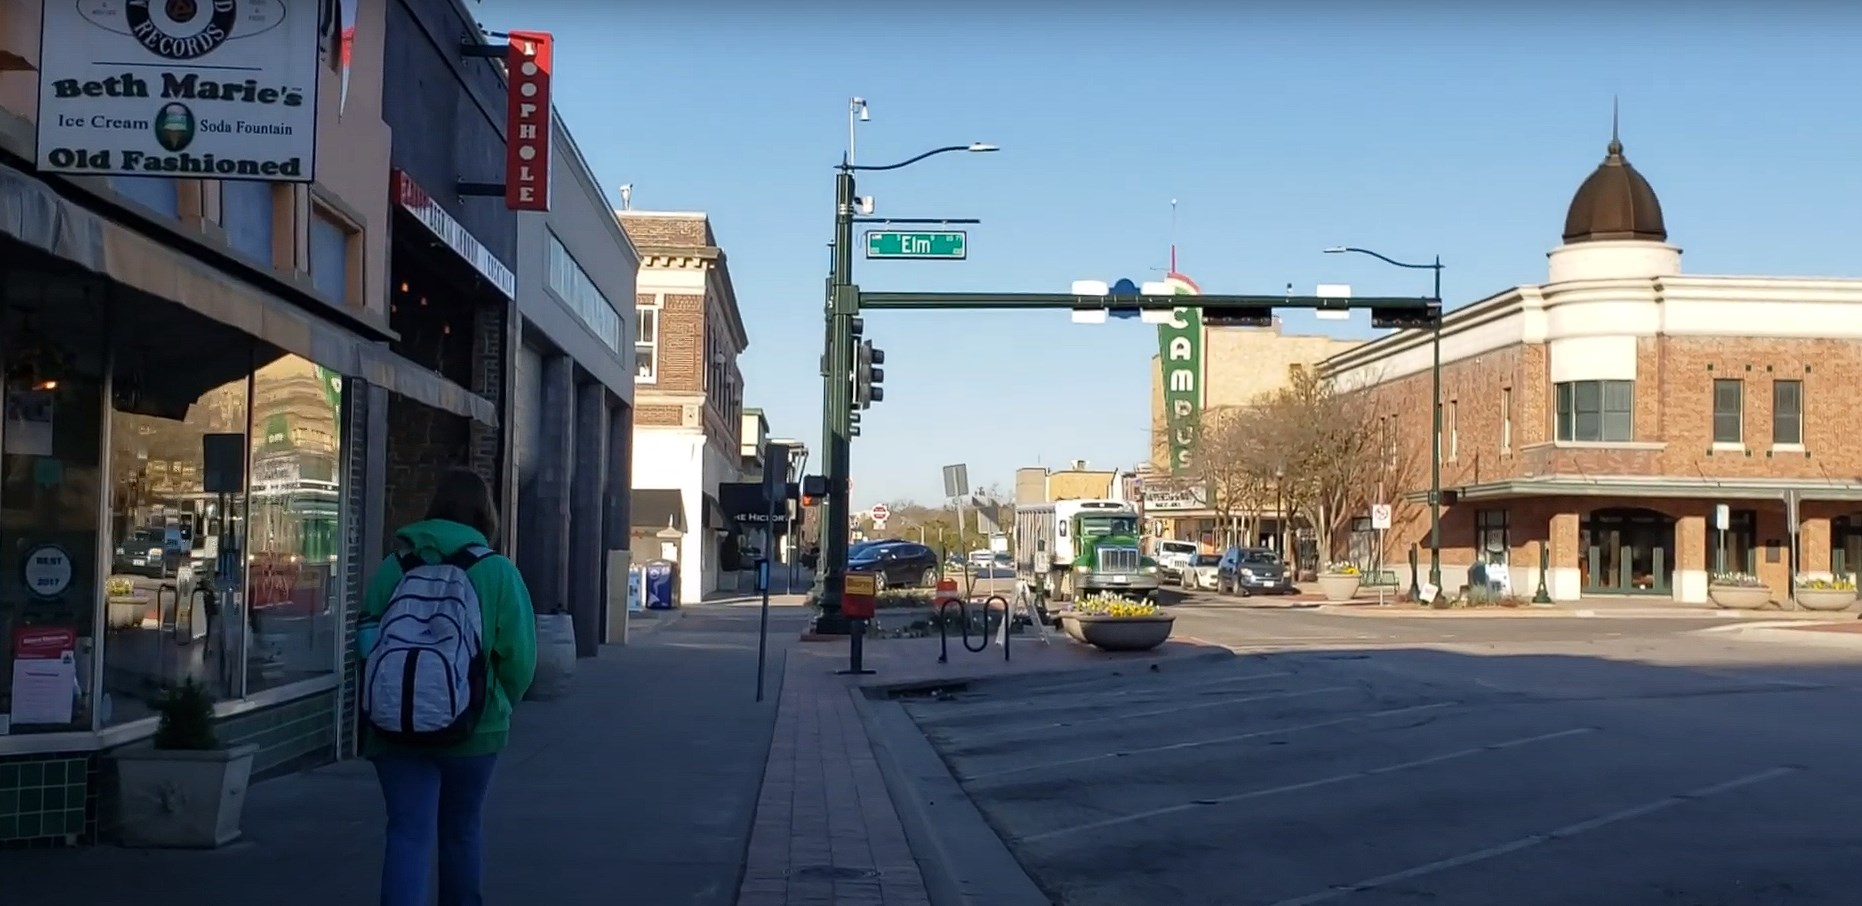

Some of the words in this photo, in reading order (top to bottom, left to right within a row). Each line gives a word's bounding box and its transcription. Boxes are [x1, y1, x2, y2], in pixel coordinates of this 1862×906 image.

[134, 21, 225, 57] RECORDS
[51, 73, 149, 98] Beth
[160, 73, 303, 106] Marie's
[58, 114, 85, 127] Ice
[91, 115, 149, 130] Cream
[200, 119, 232, 133] Soda
[236, 120, 293, 136] Fountain
[518, 40, 538, 202] LOOPHOLE
[48, 147, 111, 169] Old
[121, 150, 301, 176] Fashioned
[901, 235, 931, 254] Elm
